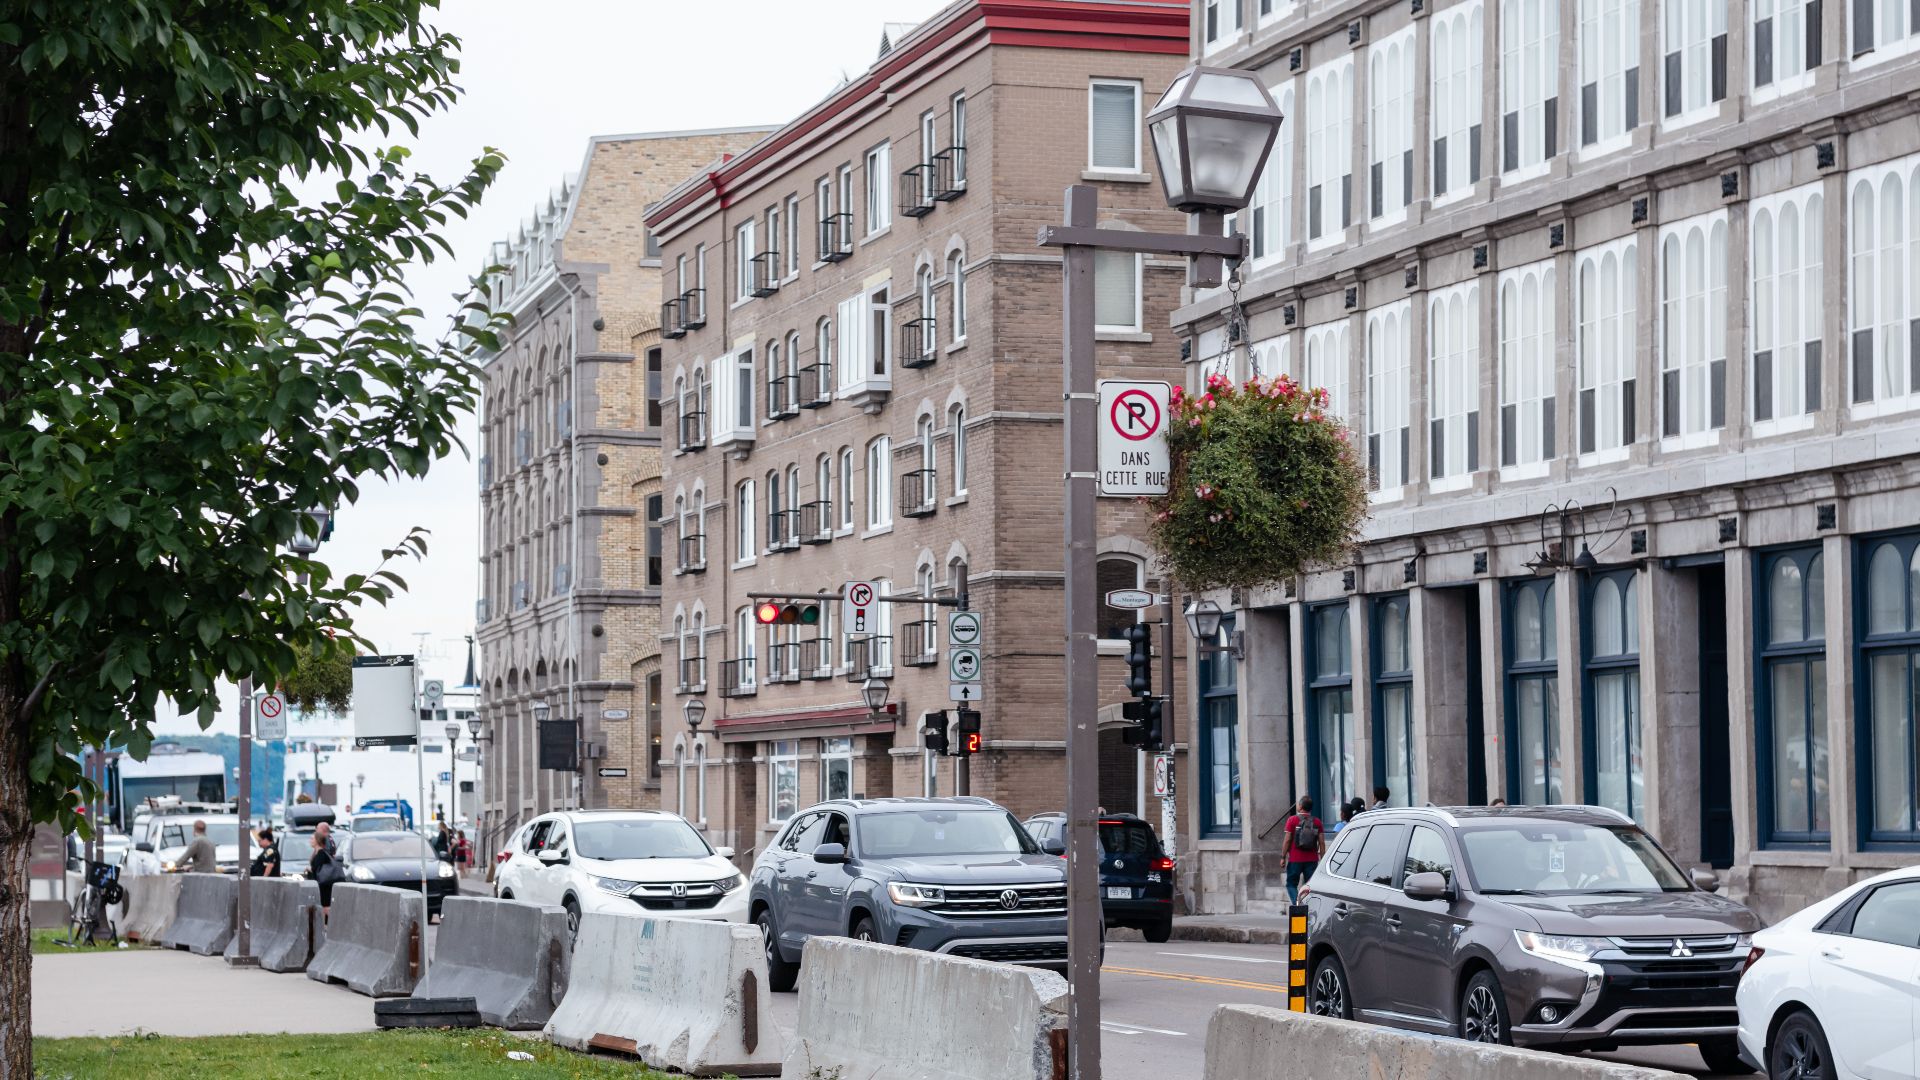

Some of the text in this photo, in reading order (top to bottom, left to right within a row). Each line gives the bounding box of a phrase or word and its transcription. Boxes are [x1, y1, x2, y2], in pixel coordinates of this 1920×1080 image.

[1121, 451, 1150, 466] DANS
[1106, 471, 1166, 486] CETTE RUE
